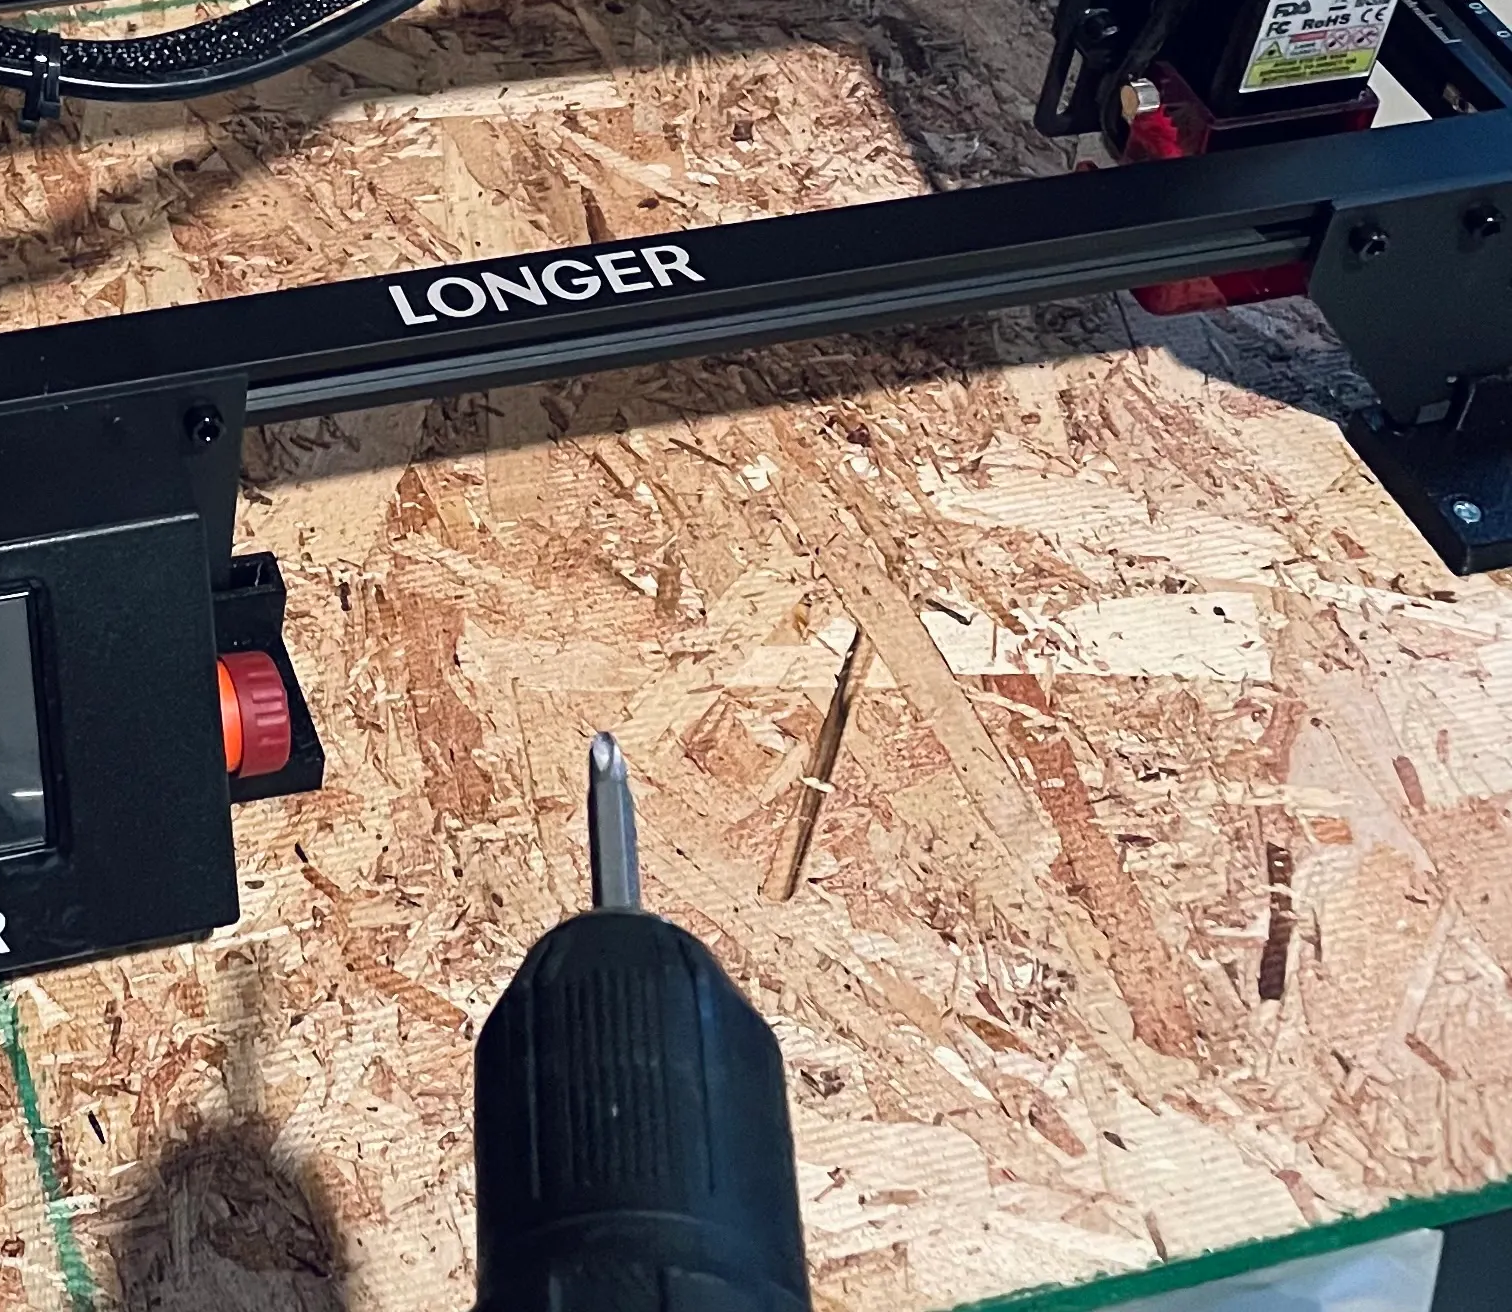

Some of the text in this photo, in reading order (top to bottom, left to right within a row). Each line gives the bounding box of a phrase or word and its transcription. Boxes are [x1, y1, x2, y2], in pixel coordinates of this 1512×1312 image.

[1302, 13, 1351, 30] RoHS
[1360, 6, 1388, 23] CE
[1496, 30, 1511, 38] 0
[388, 245, 706, 326] LONGER
